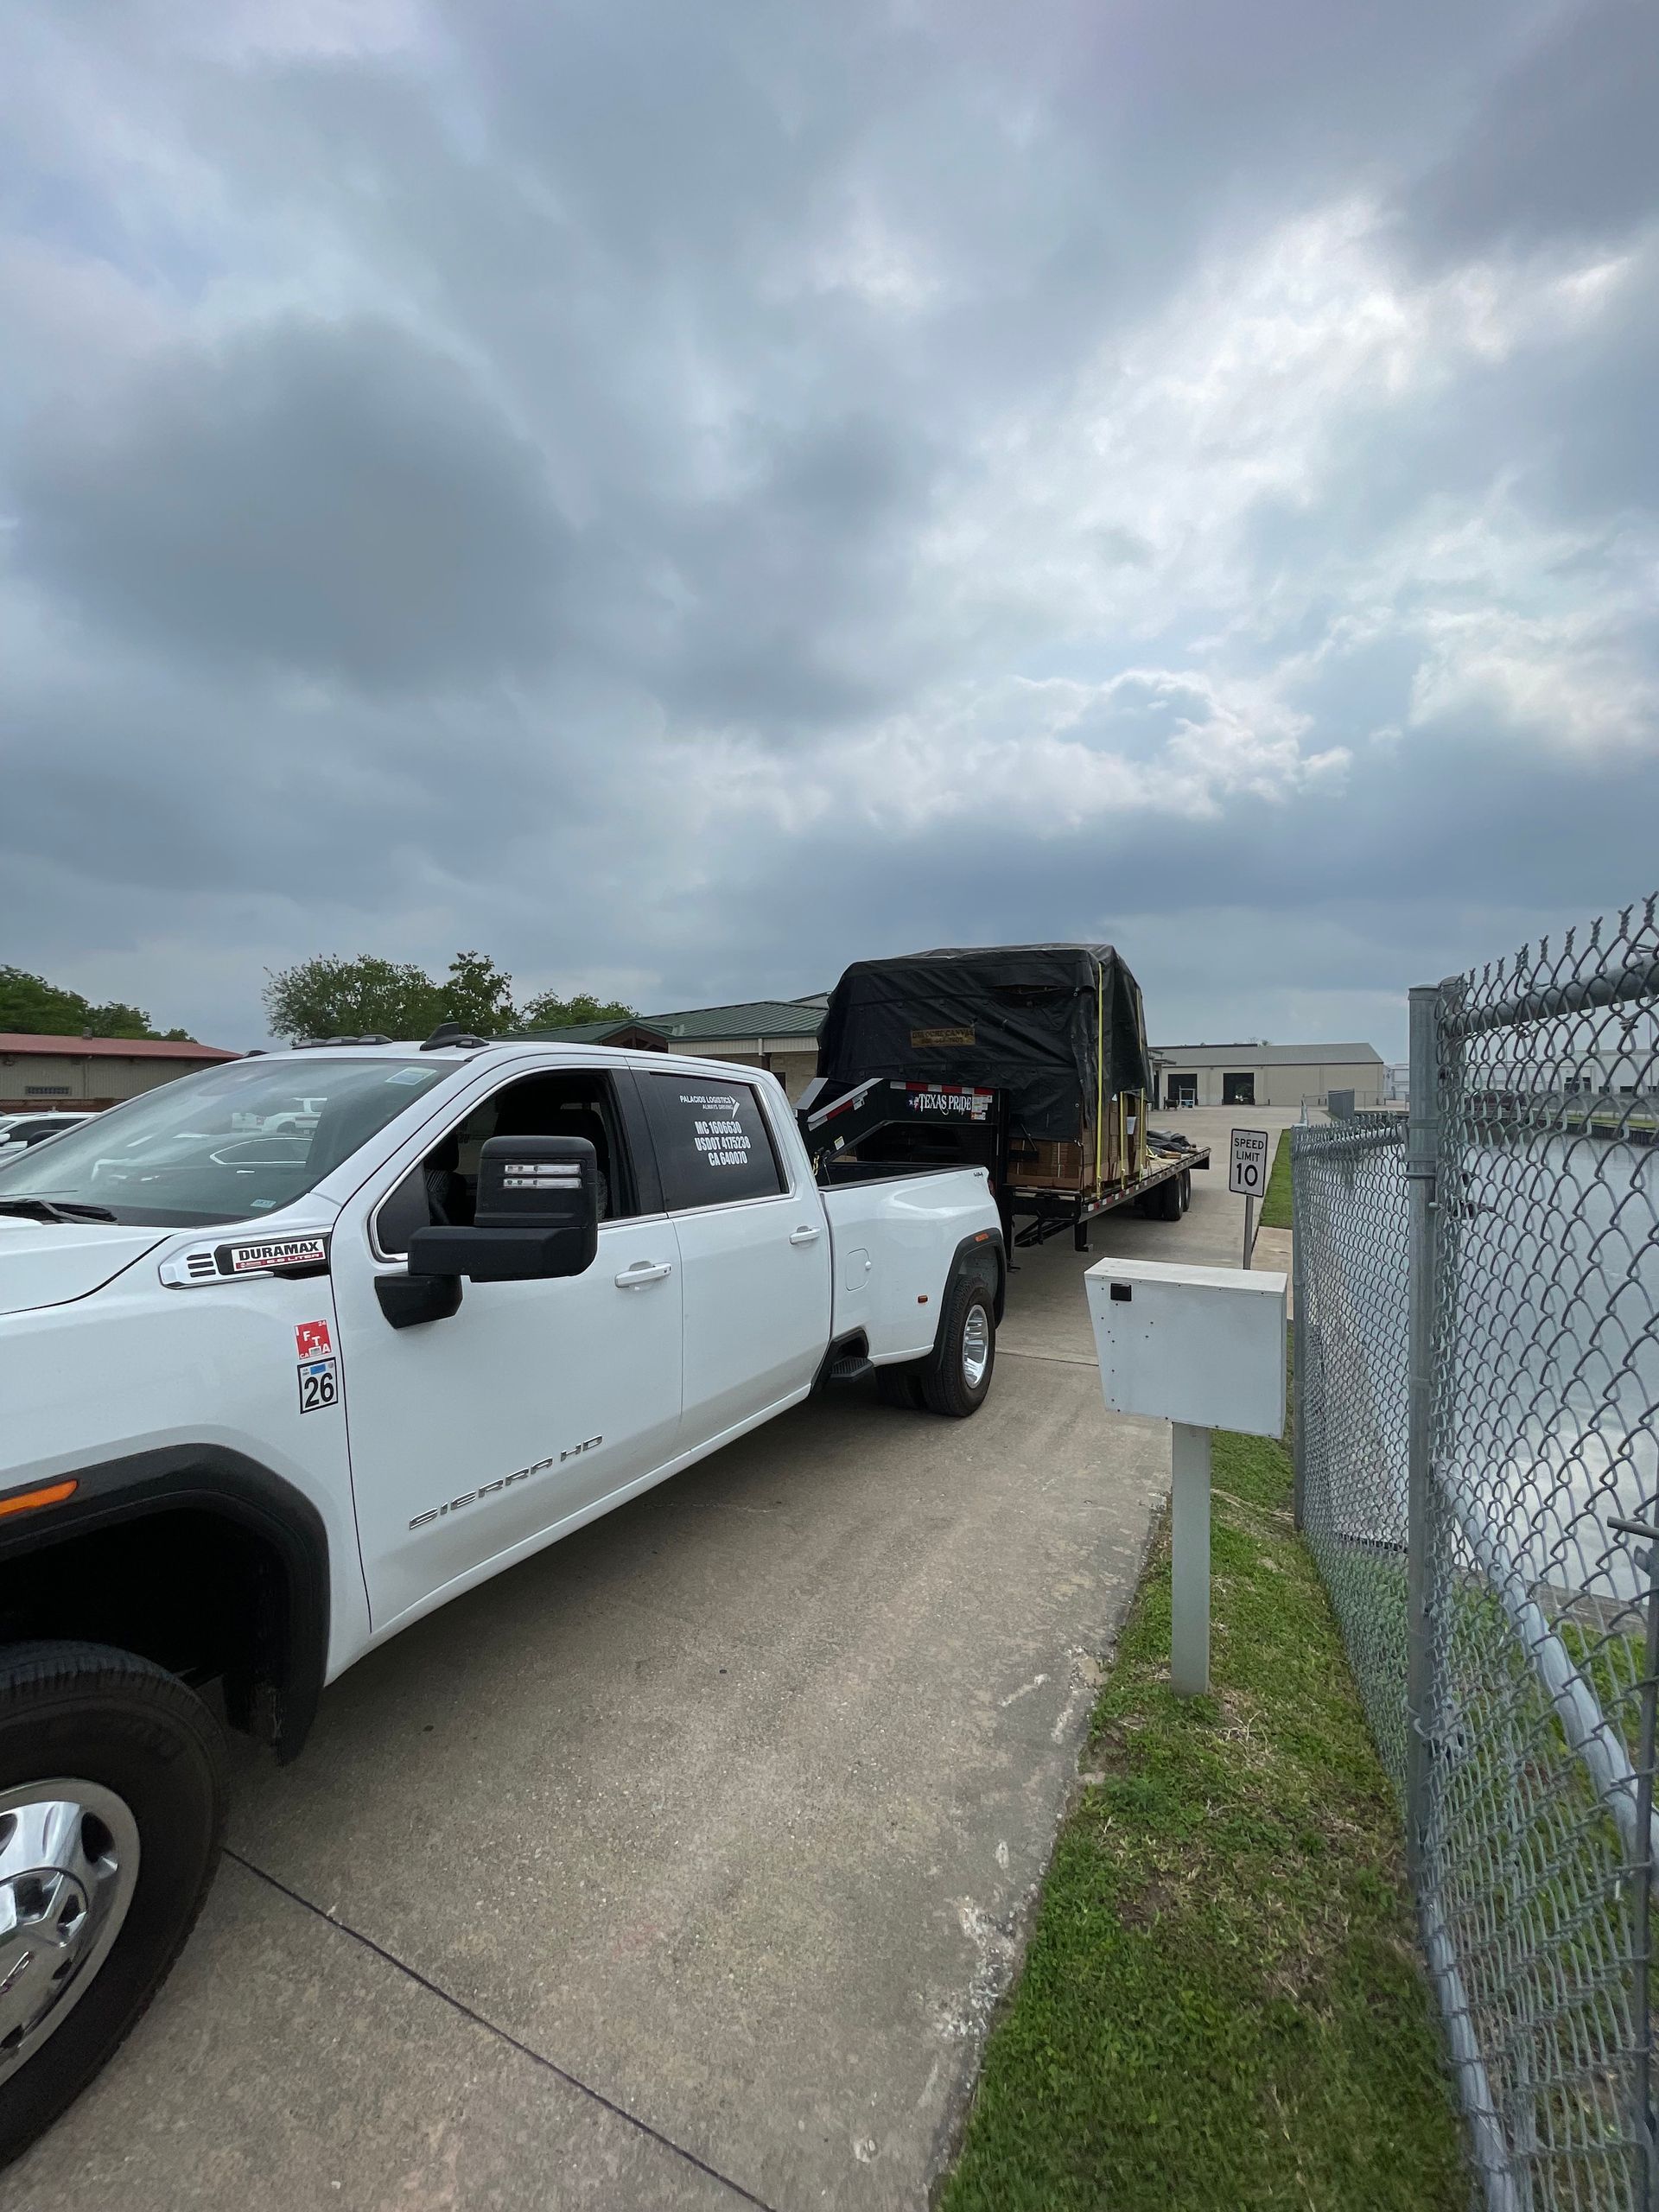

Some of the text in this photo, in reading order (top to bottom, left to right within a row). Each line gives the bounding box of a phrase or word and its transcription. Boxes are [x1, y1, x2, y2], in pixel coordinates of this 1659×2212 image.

[679, 1095, 732, 1104] PALACIOS LOGISTICS
[918, 1093, 949, 1116] TEXAS
[948, 1095, 971, 1113] PRIDE
[694, 1121, 742, 1135] MC 1606630
[694, 1135, 751, 1151] USDOT 4175238
[1234, 1137, 1264, 1150] SPEED
[708, 1150, 748, 1166] CA 640070
[1236, 1150, 1260, 1162] LIMIT
[1236, 1162, 1258, 1187] 10
[238, 1241, 320, 1262] DURAMAX
[287, 1253, 320, 1262] LITER
[304, 1372, 334, 1408] 26
[409, 1434, 603, 1530] SIERRA HD
